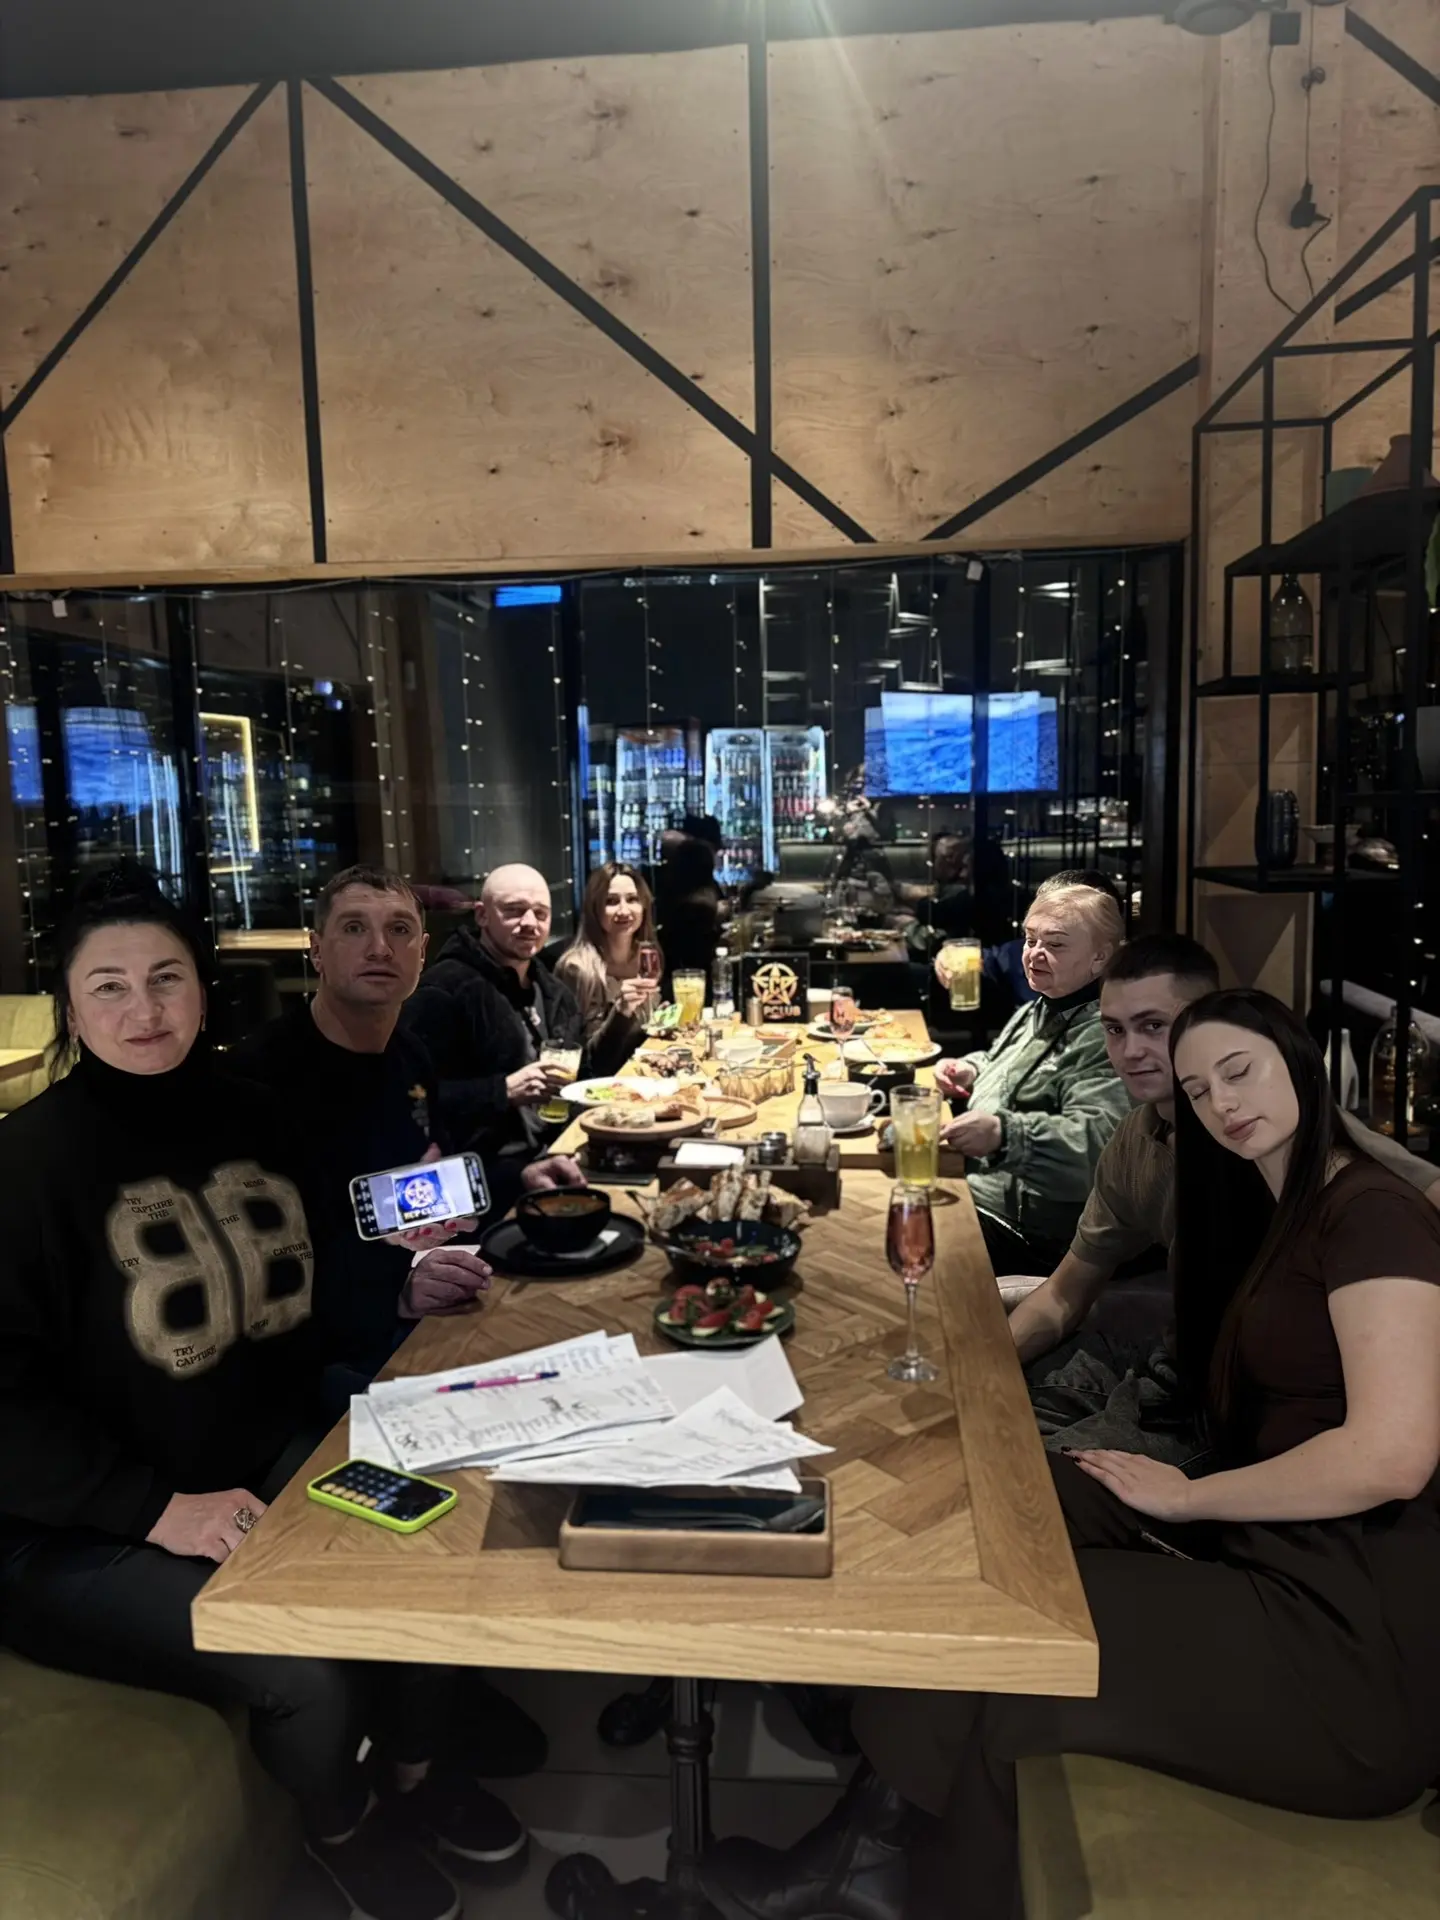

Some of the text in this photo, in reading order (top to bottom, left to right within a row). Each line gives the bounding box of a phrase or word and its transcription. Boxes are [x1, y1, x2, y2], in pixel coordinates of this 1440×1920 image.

[124, 1197, 142, 1206] TRY
[130, 1198, 175, 1214] CAPTURE
[148, 1209, 170, 1221] THE
[218, 1214, 240, 1227] THE
[273, 1241, 308, 1257] CAPTURE
[120, 1256, 140, 1269] TRY
[173, 1344, 195, 1357] TRY
[175, 1345, 217, 1368] CAPTURE
